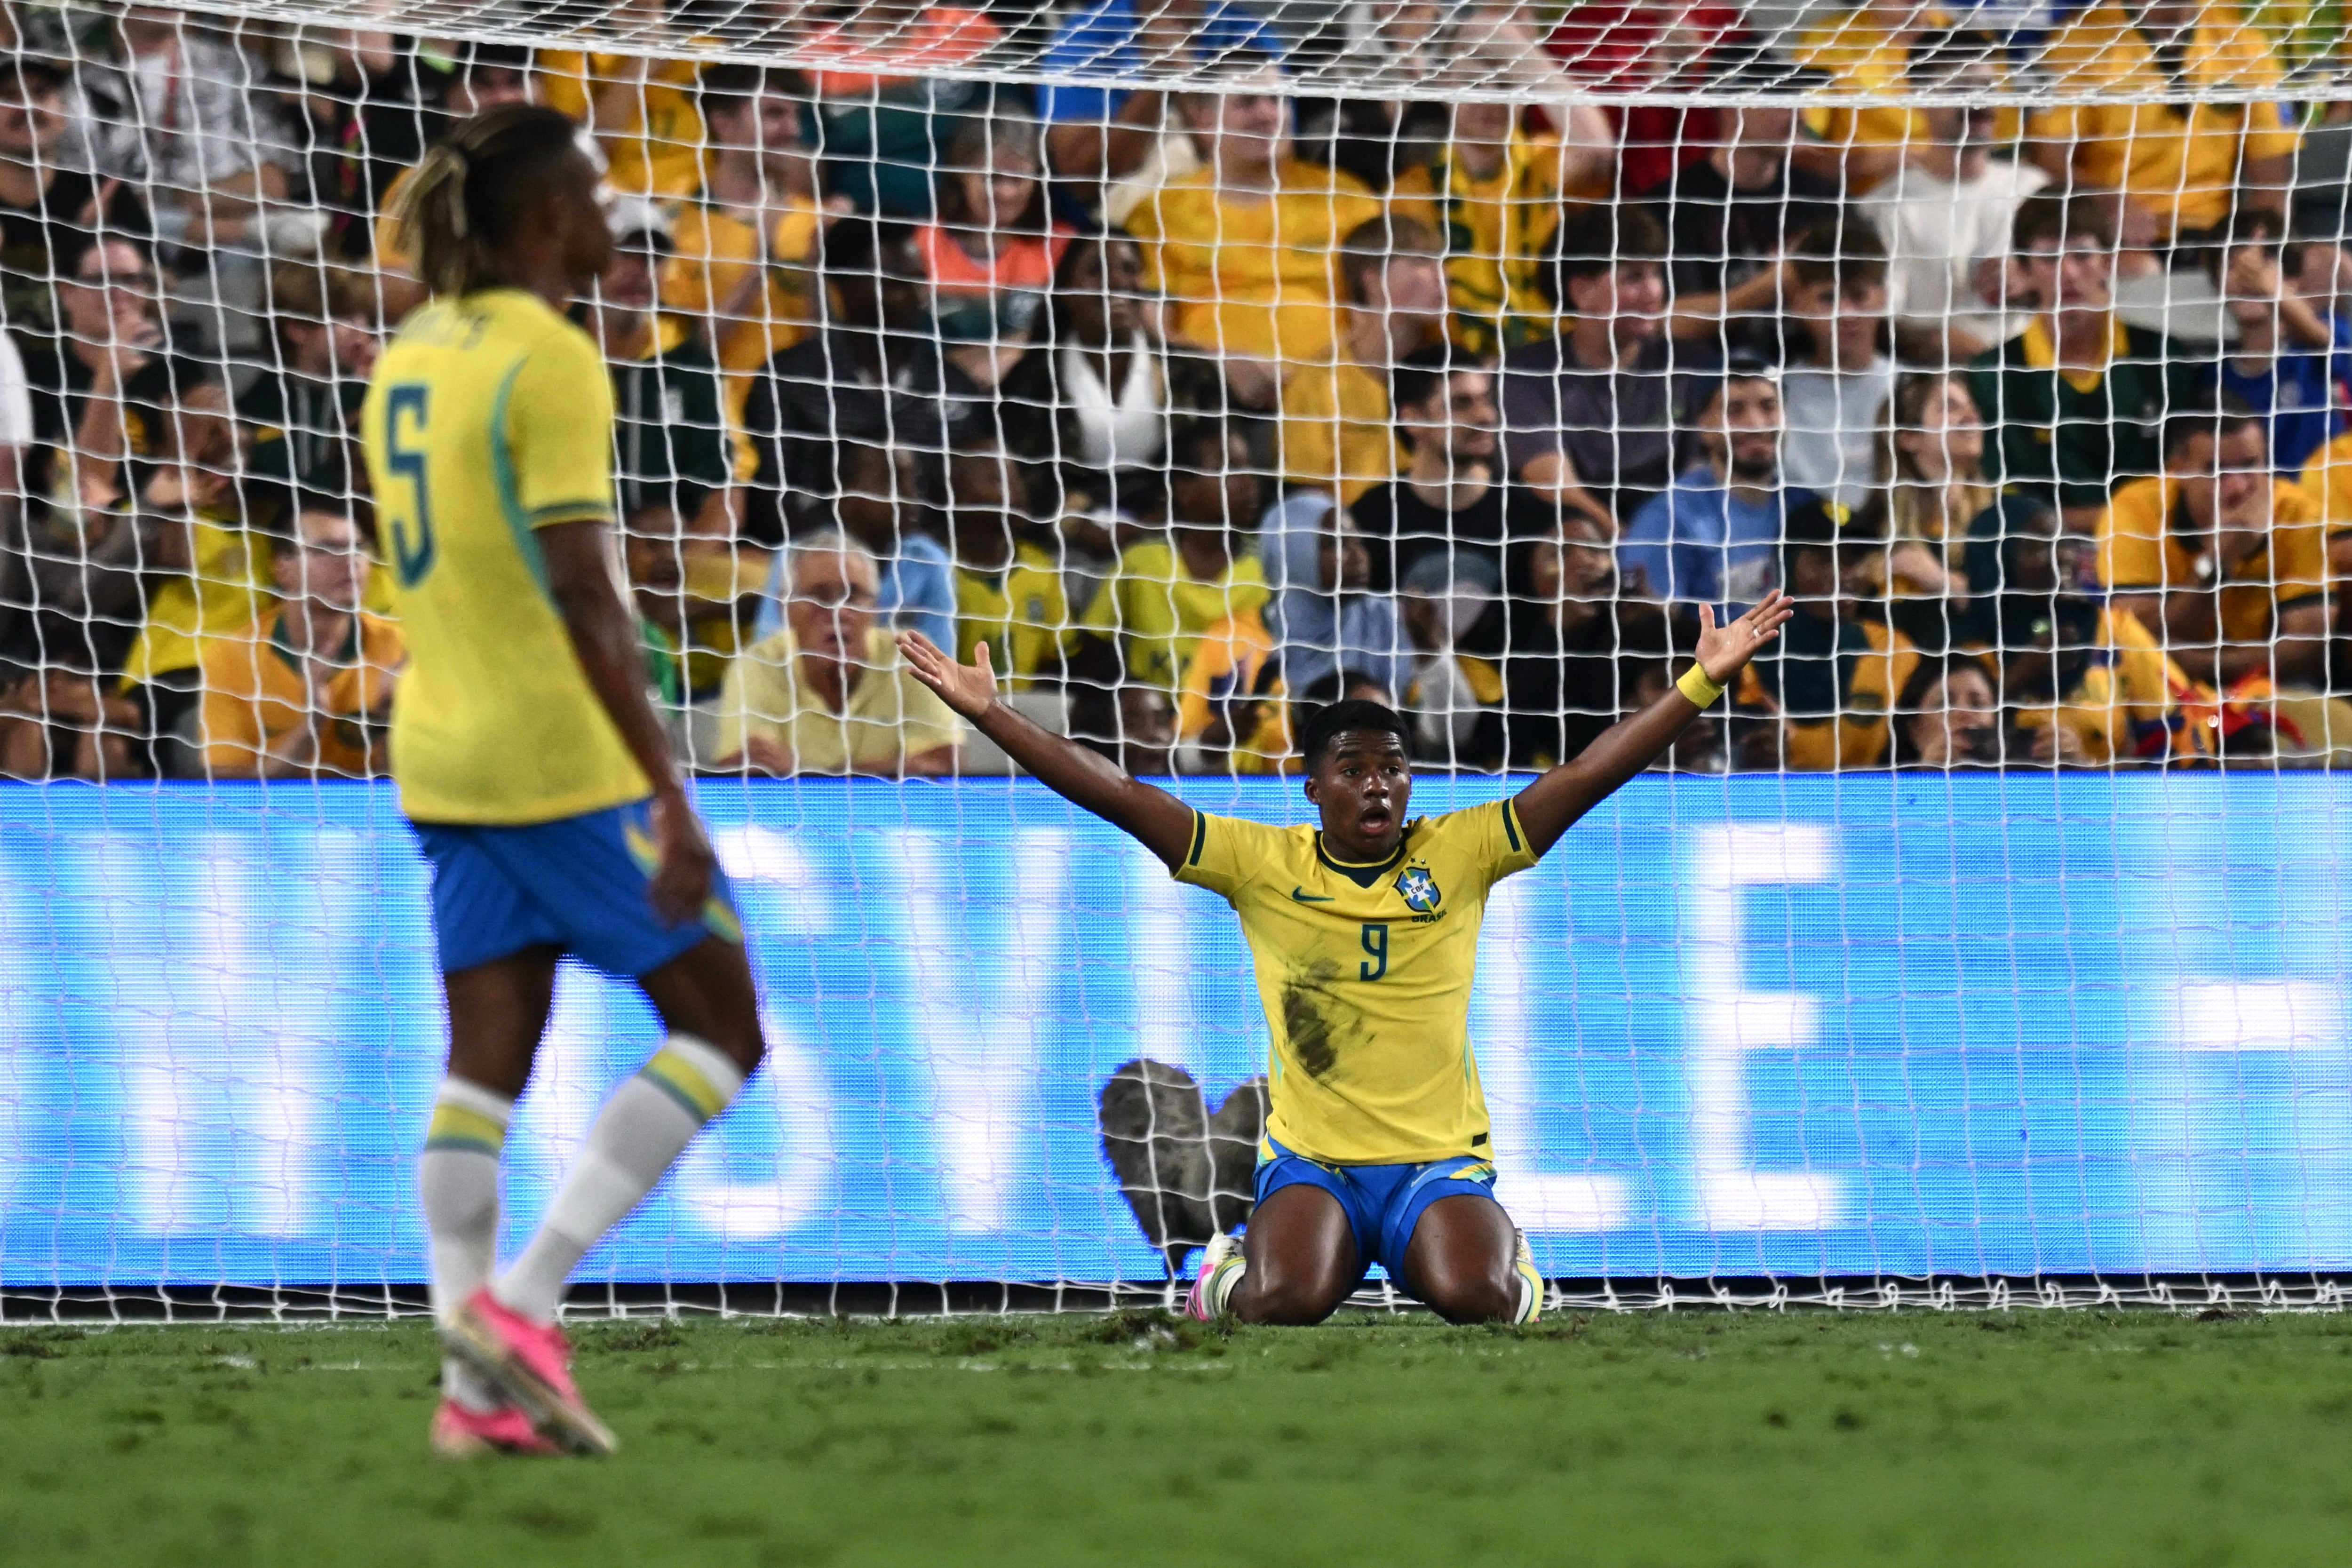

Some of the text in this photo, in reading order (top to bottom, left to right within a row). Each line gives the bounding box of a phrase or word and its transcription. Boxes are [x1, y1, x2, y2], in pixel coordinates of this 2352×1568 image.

[386, 383, 437, 590] 5
[1410, 883, 1425, 895] CBF
[1412, 908, 1447, 923] BRASIL
[1359, 923, 1389, 981] 9
